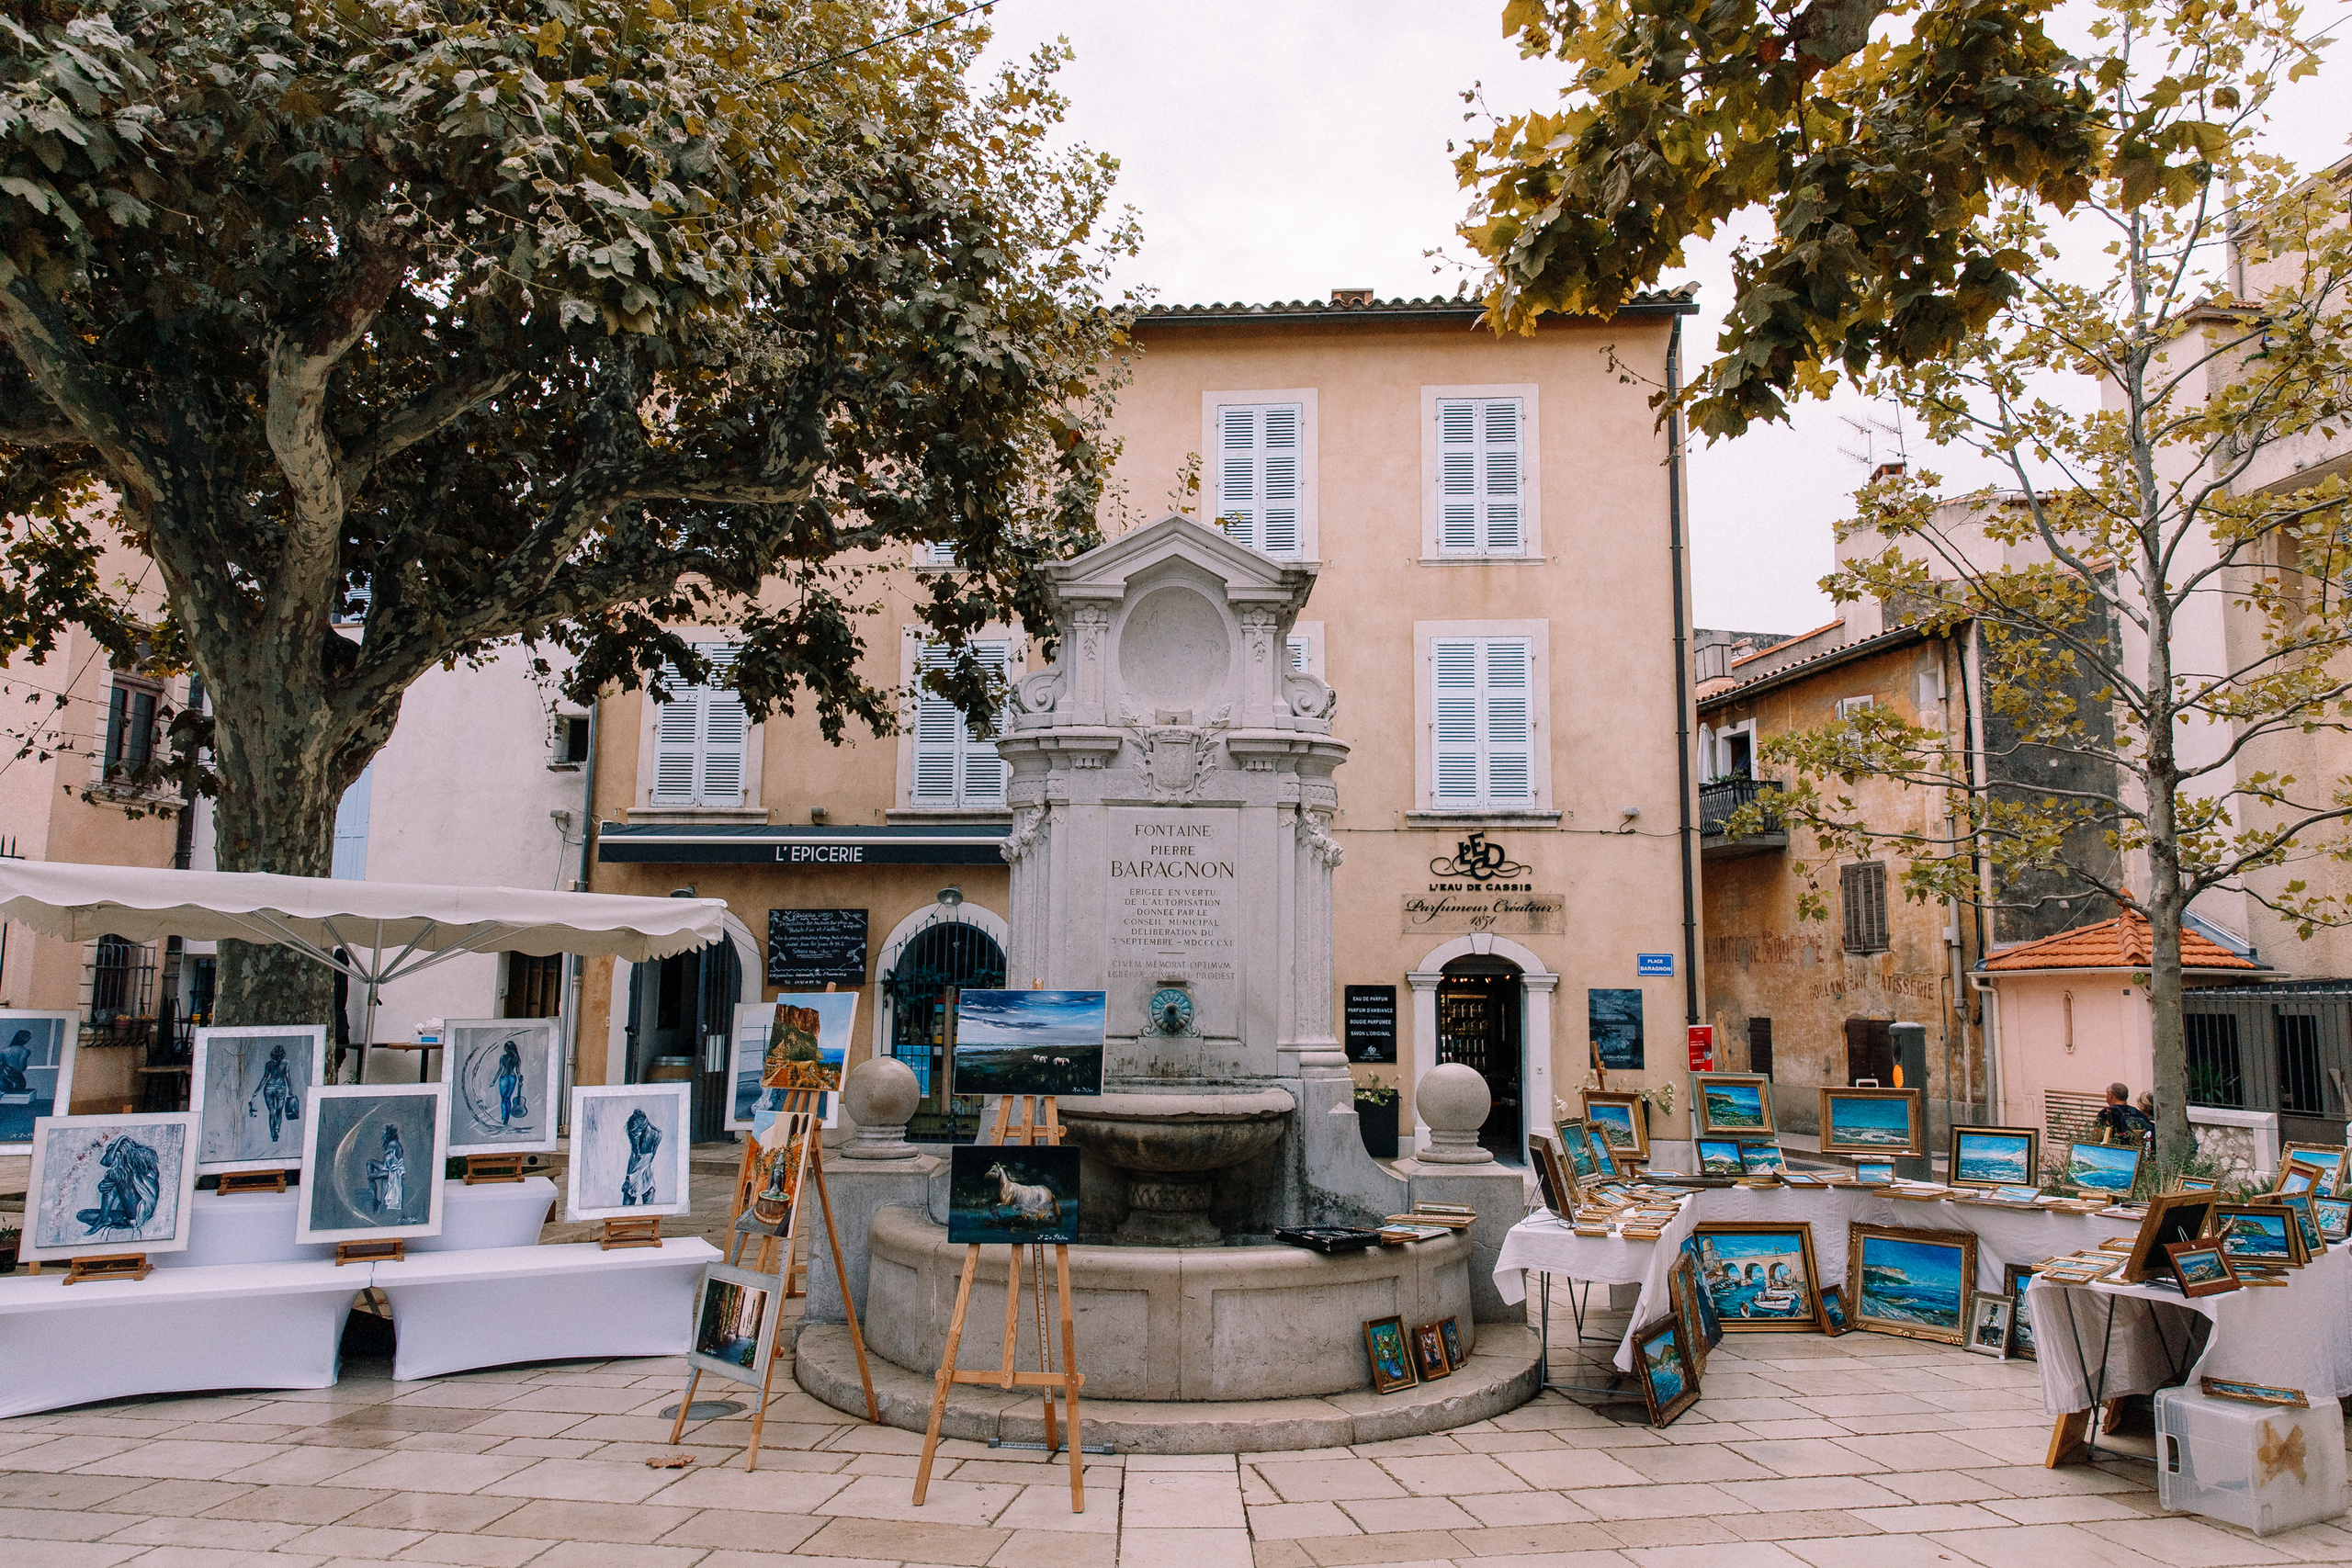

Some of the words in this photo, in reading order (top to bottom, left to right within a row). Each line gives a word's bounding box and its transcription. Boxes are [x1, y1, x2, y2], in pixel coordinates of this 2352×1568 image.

[1135, 824, 1212, 838] FONTAINE
[1150, 845, 1196, 856] PIERRE
[1111, 860, 1235, 879] BARAGNON
[1429, 883, 1464, 892] L'EAU
[1466, 883, 1483, 892] DE
[1485, 883, 1532, 892] CASSIS
[1129, 888, 1164, 897] ERIGEE
[1168, 888, 1182, 897] EN
[1184, 888, 1217, 897] VERTU
[1124, 897, 1137, 906] DE
[1142, 897, 1221, 907] L'AUTORISATION
[1136, 908, 1175, 917] DONNEE
[1177, 908, 1194, 917] PAR
[1404, 896, 1488, 925] Parfumeur
[1492, 897, 1563, 914] Créateur
[1123, 918, 1163, 927] CONSEIL
[1168, 919, 1220, 927] MUNICIPAL
[1131, 928, 1198, 937] DELIBERATION
[1201, 929, 1215, 937] DU
[1120, 937, 1174, 946] SEPTEMBRE
[1195, 972, 1236, 980] PRODEST
